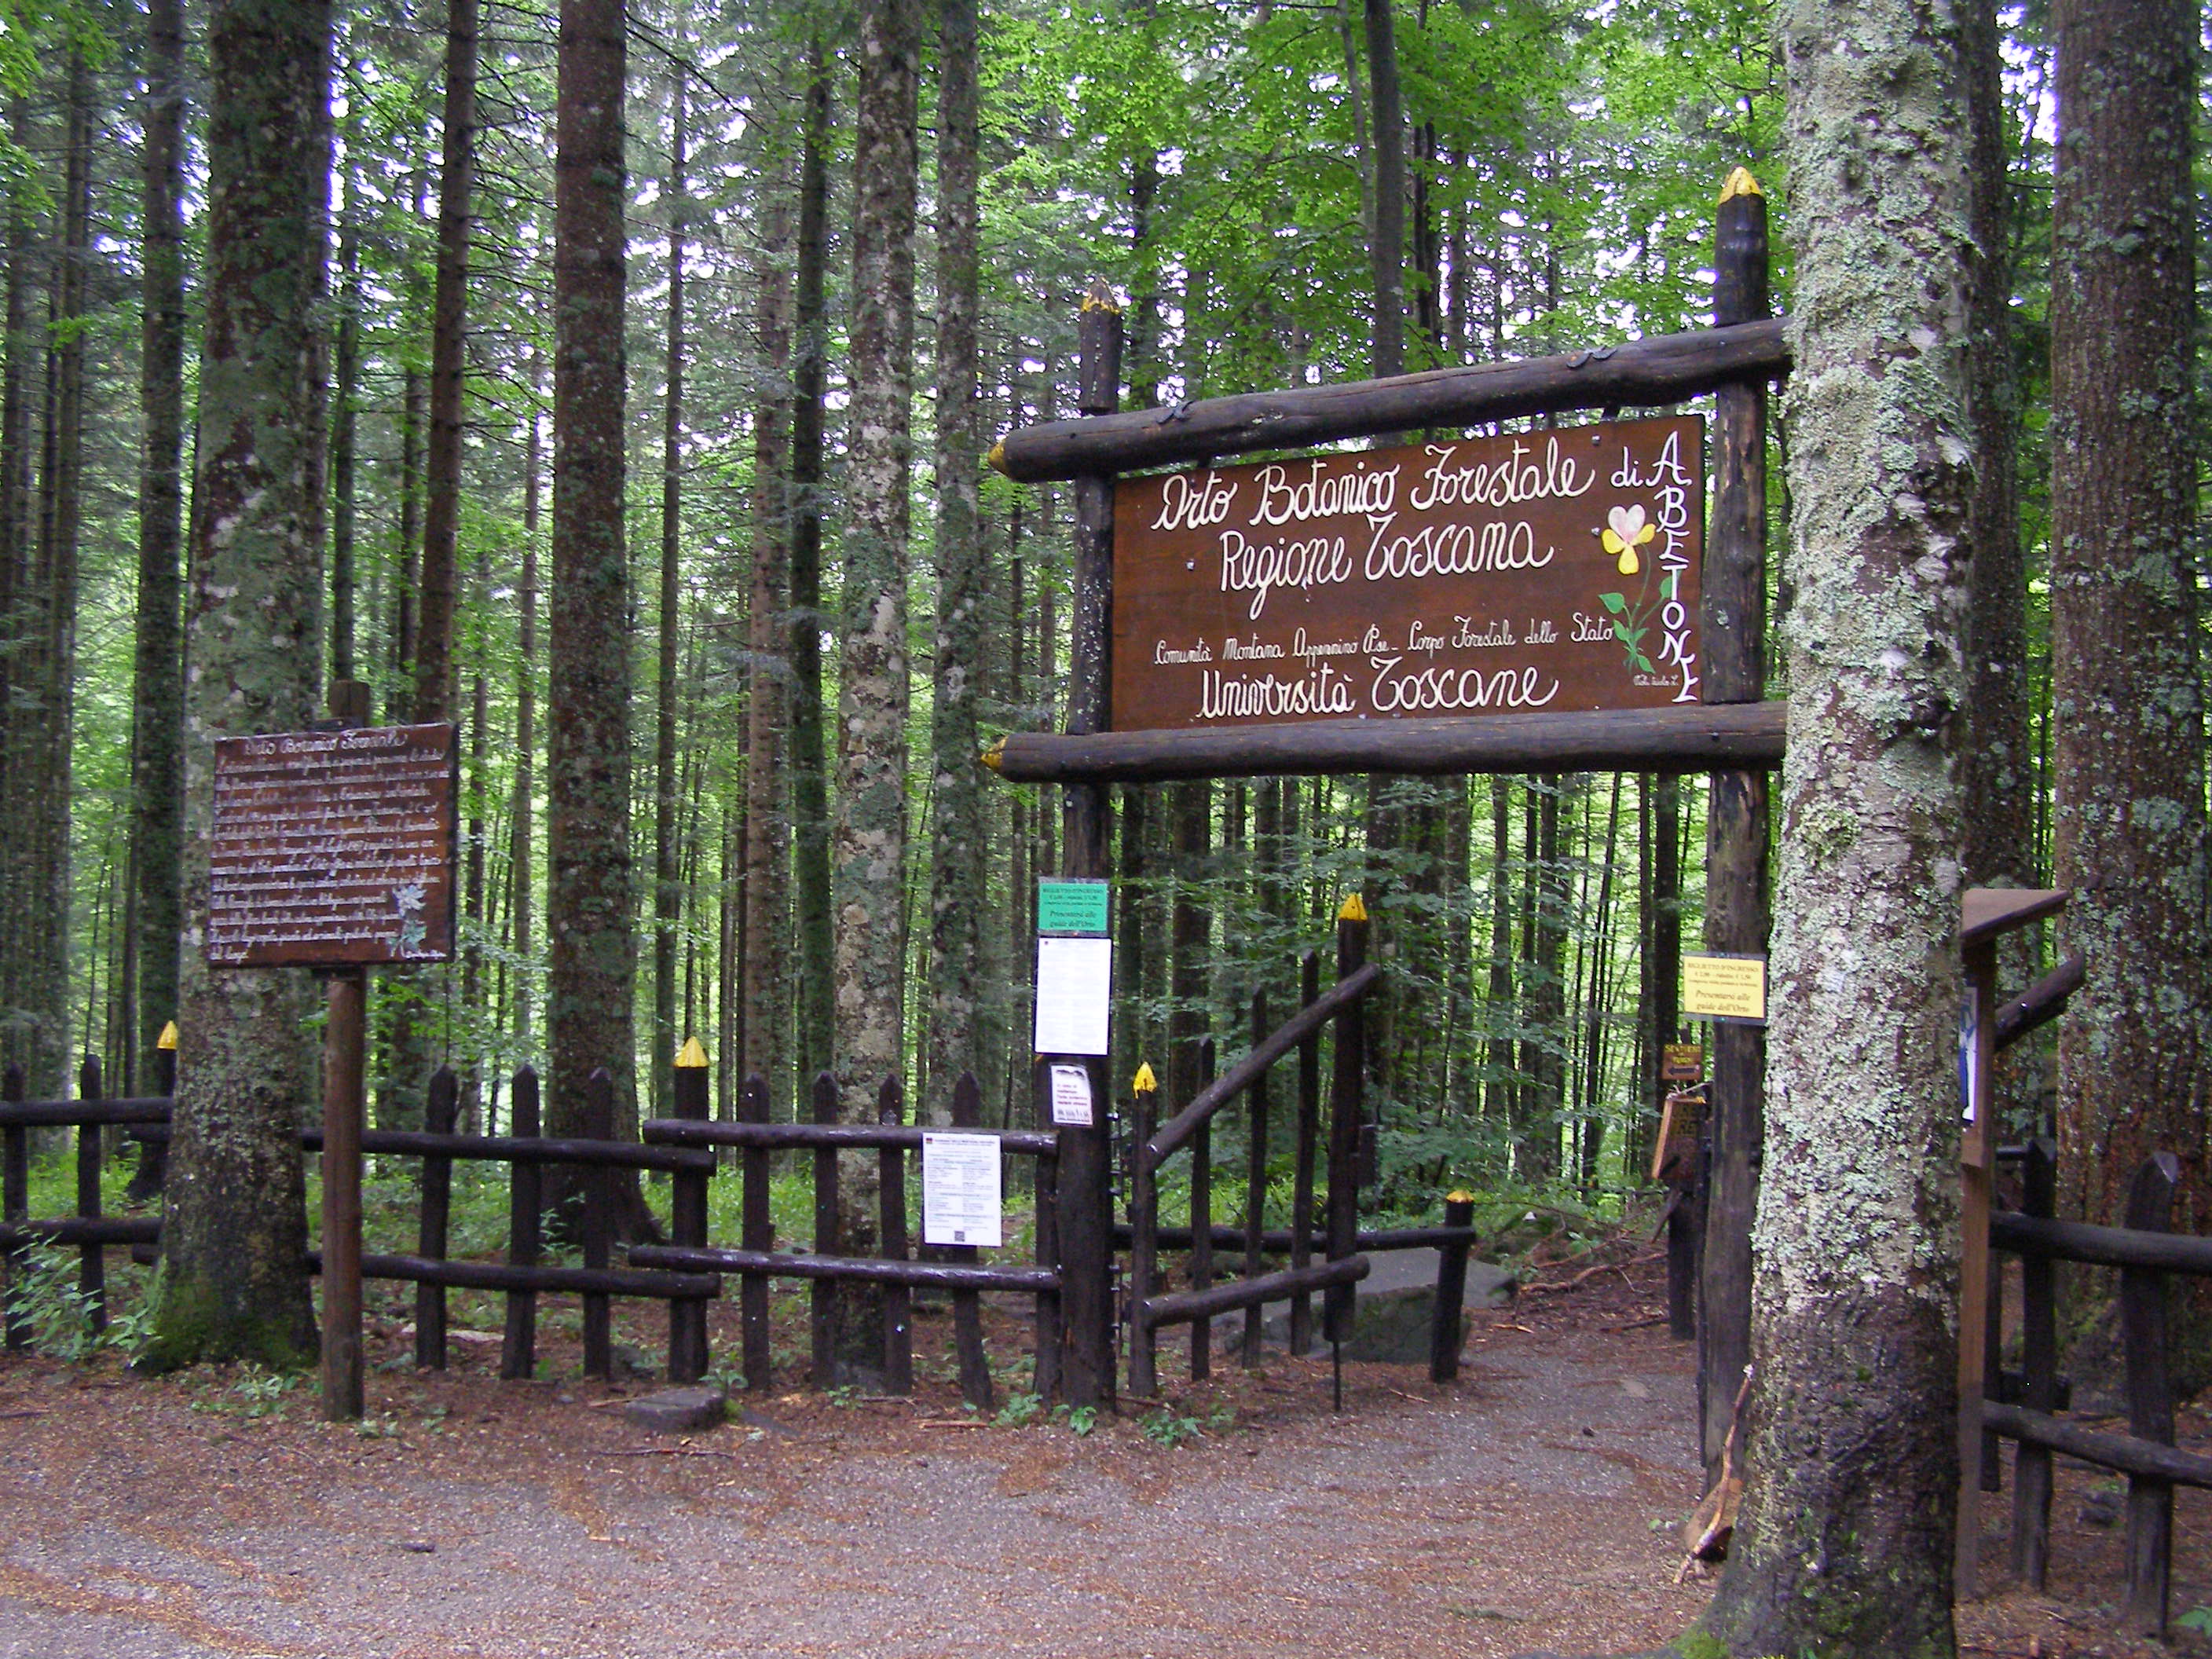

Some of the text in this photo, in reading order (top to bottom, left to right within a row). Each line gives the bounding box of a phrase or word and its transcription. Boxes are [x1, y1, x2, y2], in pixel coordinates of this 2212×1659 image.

[1150, 436, 1644, 531] Orto Botanico Forestale di
[1219, 511, 1555, 621] Regione Toscana
[1646, 430, 1699, 703] ABETONE
[1155, 637, 1213, 665] Comunità
[1222, 632, 1286, 661] Montana
[1292, 627, 1359, 668] Appennino
[1407, 619, 1445, 659] Corpo
[1452, 614, 1517, 650] Forestale
[1523, 618, 1559, 645] dello
[1570, 611, 1614, 643] Stato
[1196, 654, 1559, 719] Università Toscane
